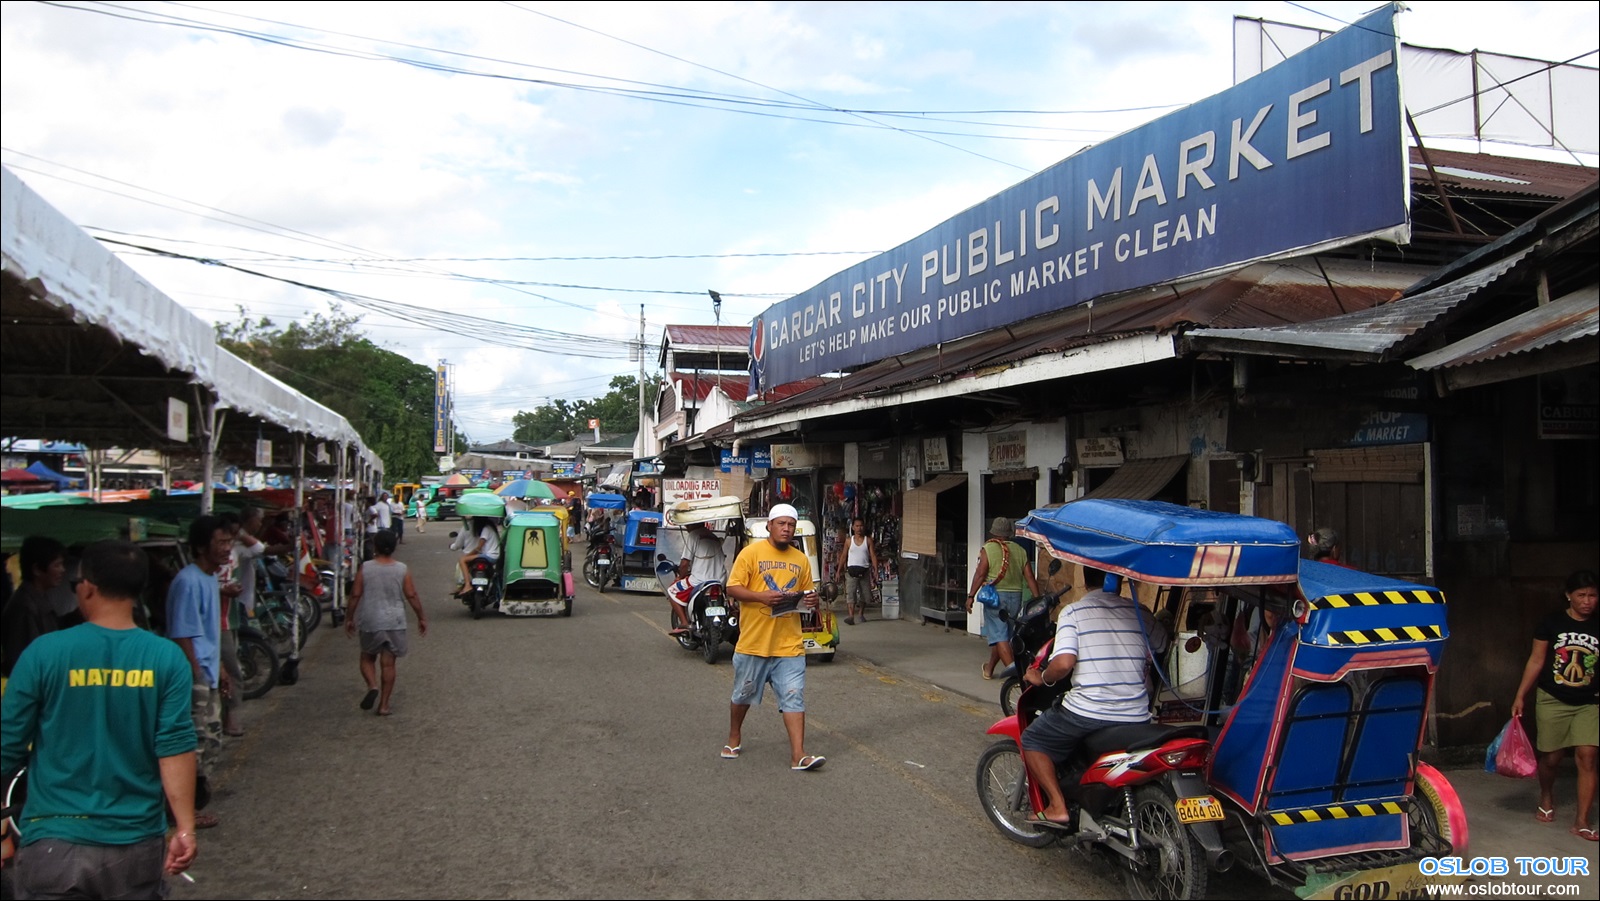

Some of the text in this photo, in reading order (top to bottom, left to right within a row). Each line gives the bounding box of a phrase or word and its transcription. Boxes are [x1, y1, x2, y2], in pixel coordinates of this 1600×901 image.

[770, 49, 1393, 350] CARCAR CITY PUBLIC MARKET
[799, 203, 1217, 363] LET'S HELP MAKE OUR PUBLIC MARKET CLEAN
[1366, 425, 1410, 441] MARKET
[665, 481, 719, 491] UNLOADING AREA
[684, 491, 701, 500] ONLY
[758, 560, 802, 578] BOULDER CITY
[1557, 632, 1599, 645] STOP
[69, 668, 154, 688] NATDOA
[1179, 805, 1206, 821] 8444
[1334, 879, 1390, 901] GOD
[1405, 875, 1437, 890] bless
